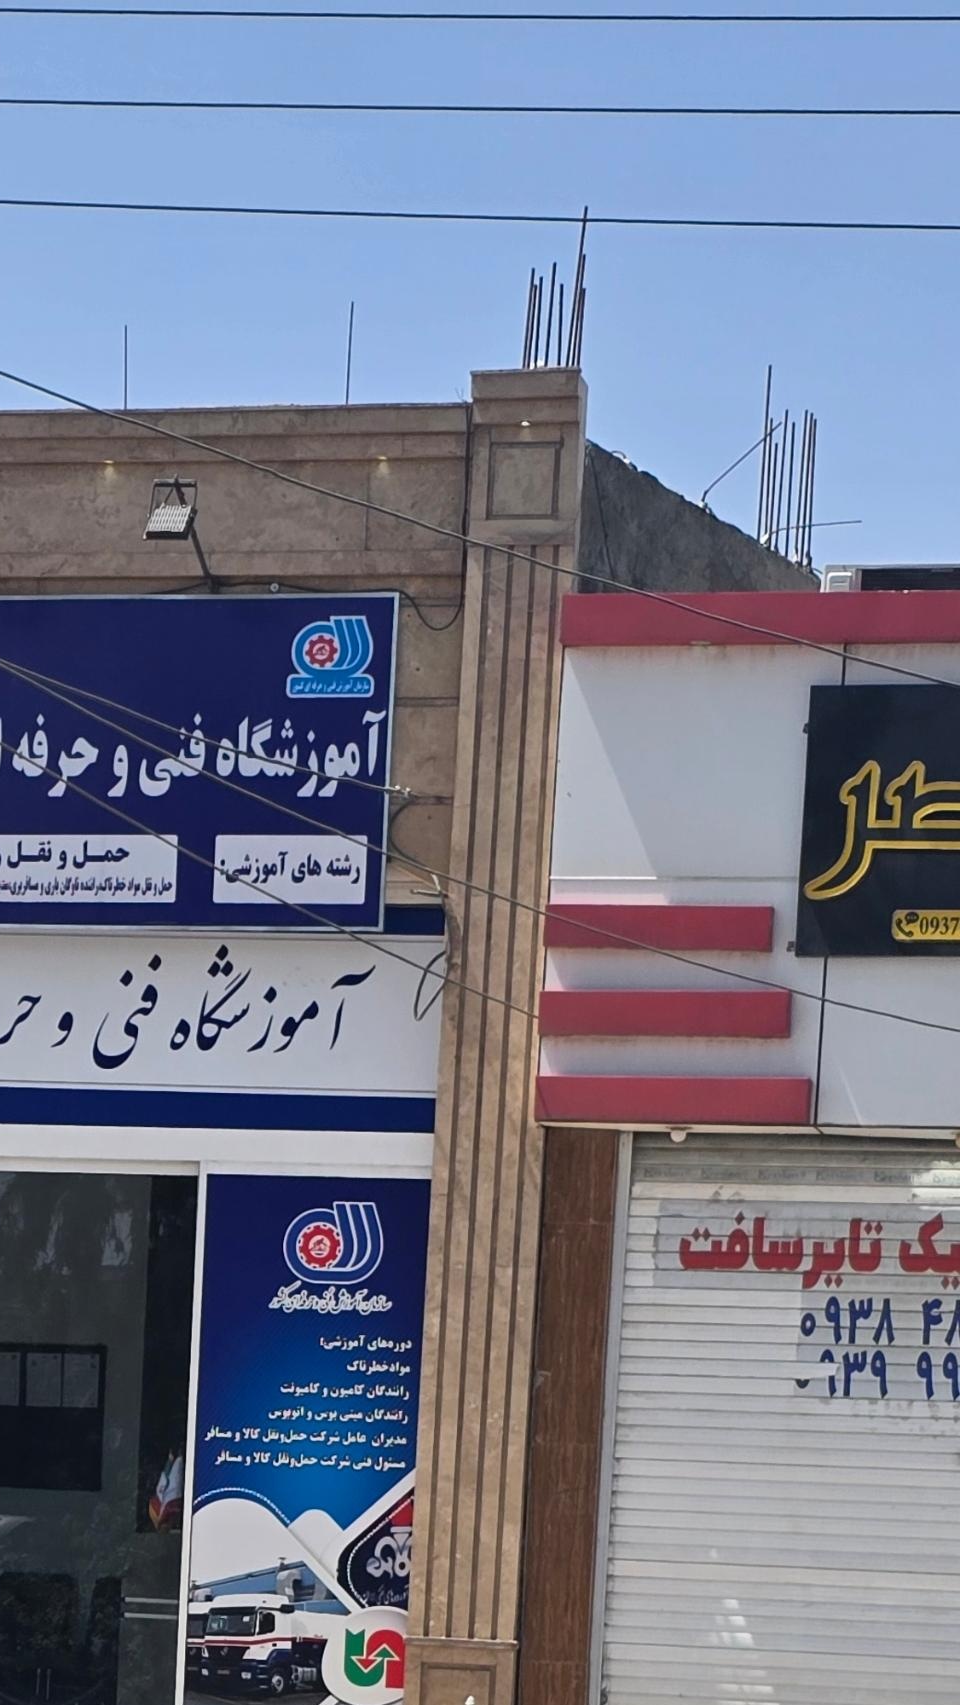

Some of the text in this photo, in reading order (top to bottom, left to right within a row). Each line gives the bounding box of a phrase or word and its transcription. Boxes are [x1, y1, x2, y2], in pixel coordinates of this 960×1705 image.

[14, 714, 99, 800] حرفه
[139, 714, 208, 798] فنی
[215, 708, 388, 799] آموزشگاه
[107, 745, 130, 798] و
[7, 840, 52, 868] نقل
[56, 850, 67, 869] و
[73, 840, 130, 869] حمل
[219, 851, 360, 884] رشته های آموزشی:
[141, 877, 152, 896] نقل
[158, 876, 173, 896] حمل
[168, 944, 379, 1056] آموزشگاه
[90, 953, 165, 1071] فنی
[49, 1008, 76, 1049] و
[280, 1383, 409, 1400] رانندگان کامیون و کامیونت
[268, 1406, 408, 1424] رانندگان مینی بوس و اتوبوس
[205, 1425, 232, 1440] مسافر
[234, 1432, 240, 1442] و
[242, 1428, 260, 1439] کالا
[310, 1431, 340, 1444] شرکت
[342, 1432, 366, 1444] عامل
[371, 1433, 406, 1447] مدیران
[215, 1449, 242, 1464] مسافر
[244, 1456, 250, 1466] و
[253, 1452, 271, 1463] کالا
[320, 1455, 350, 1469] شرکت
[353, 1457, 372, 1470] فنی
[374, 1456, 406, 1471] مسئول
